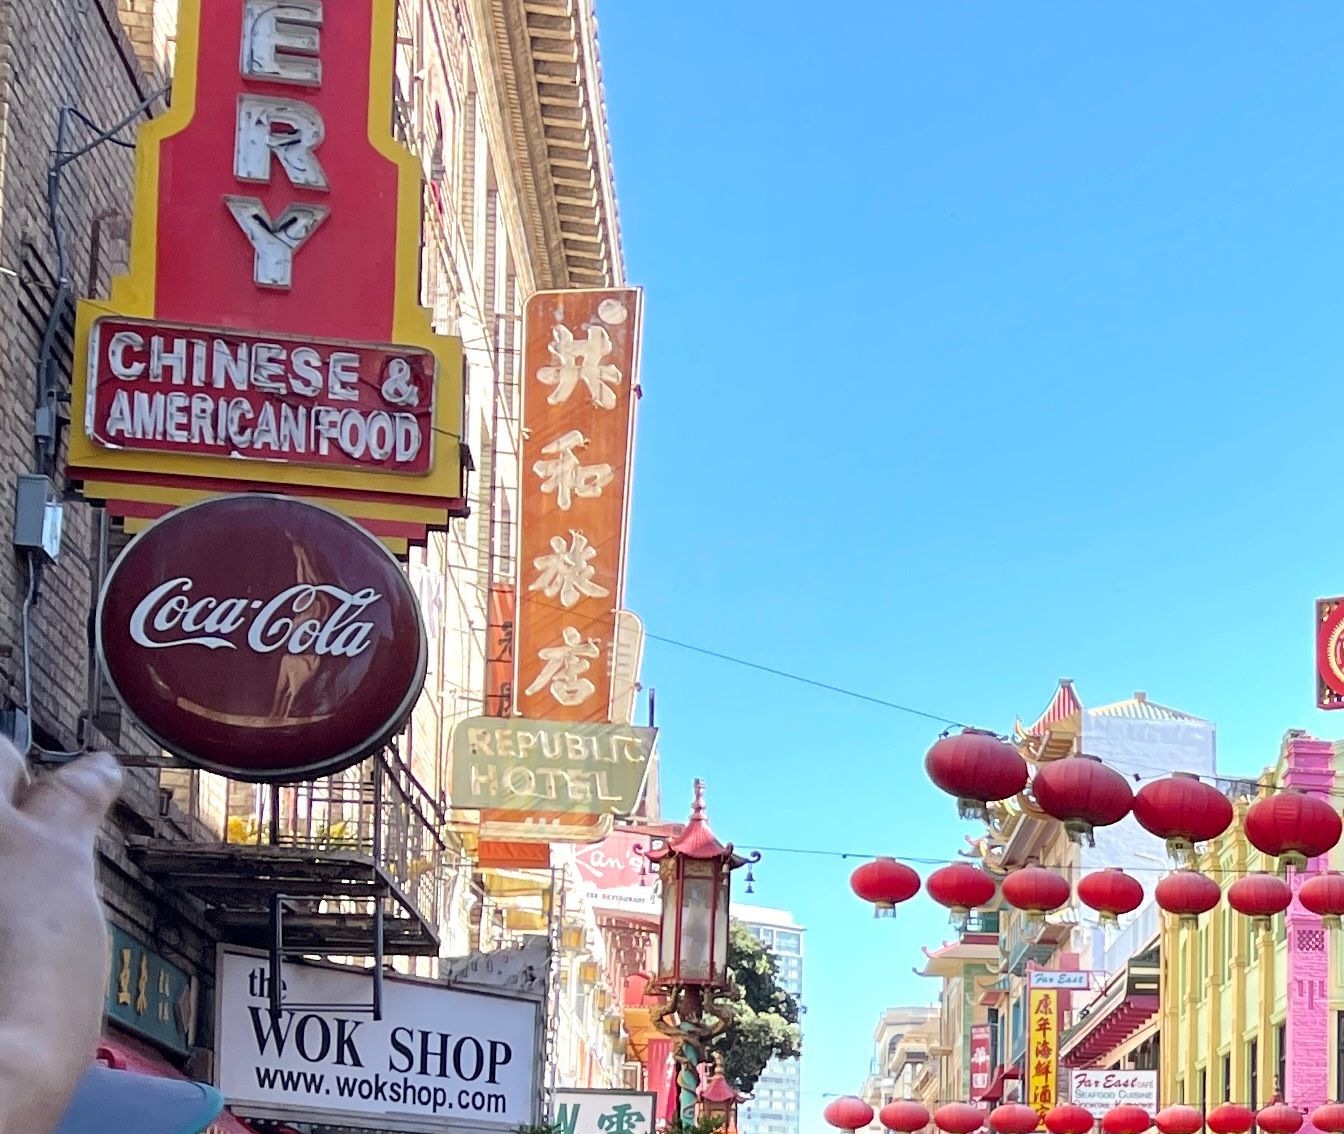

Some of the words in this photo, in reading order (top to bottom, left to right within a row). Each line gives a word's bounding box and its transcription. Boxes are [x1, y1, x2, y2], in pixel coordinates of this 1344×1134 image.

[108, 331, 360, 401] CHINESE
[381, 357, 420, 407] &
[106, 388, 306, 454] AMERICAN
[310, 404, 423, 462] FOOD
[129, 577, 382, 658] Coca-Cola
[466, 727, 646, 763] REPUBLIC
[470, 764, 623, 802] HOTEL
[248, 1006, 364, 1068] WOK
[389, 1027, 512, 1084] SHOP
[255, 1067, 506, 1113] www.wokshop.com
[1075, 1074, 1099, 1088] Far
[1103, 1074, 1137, 1088] East
